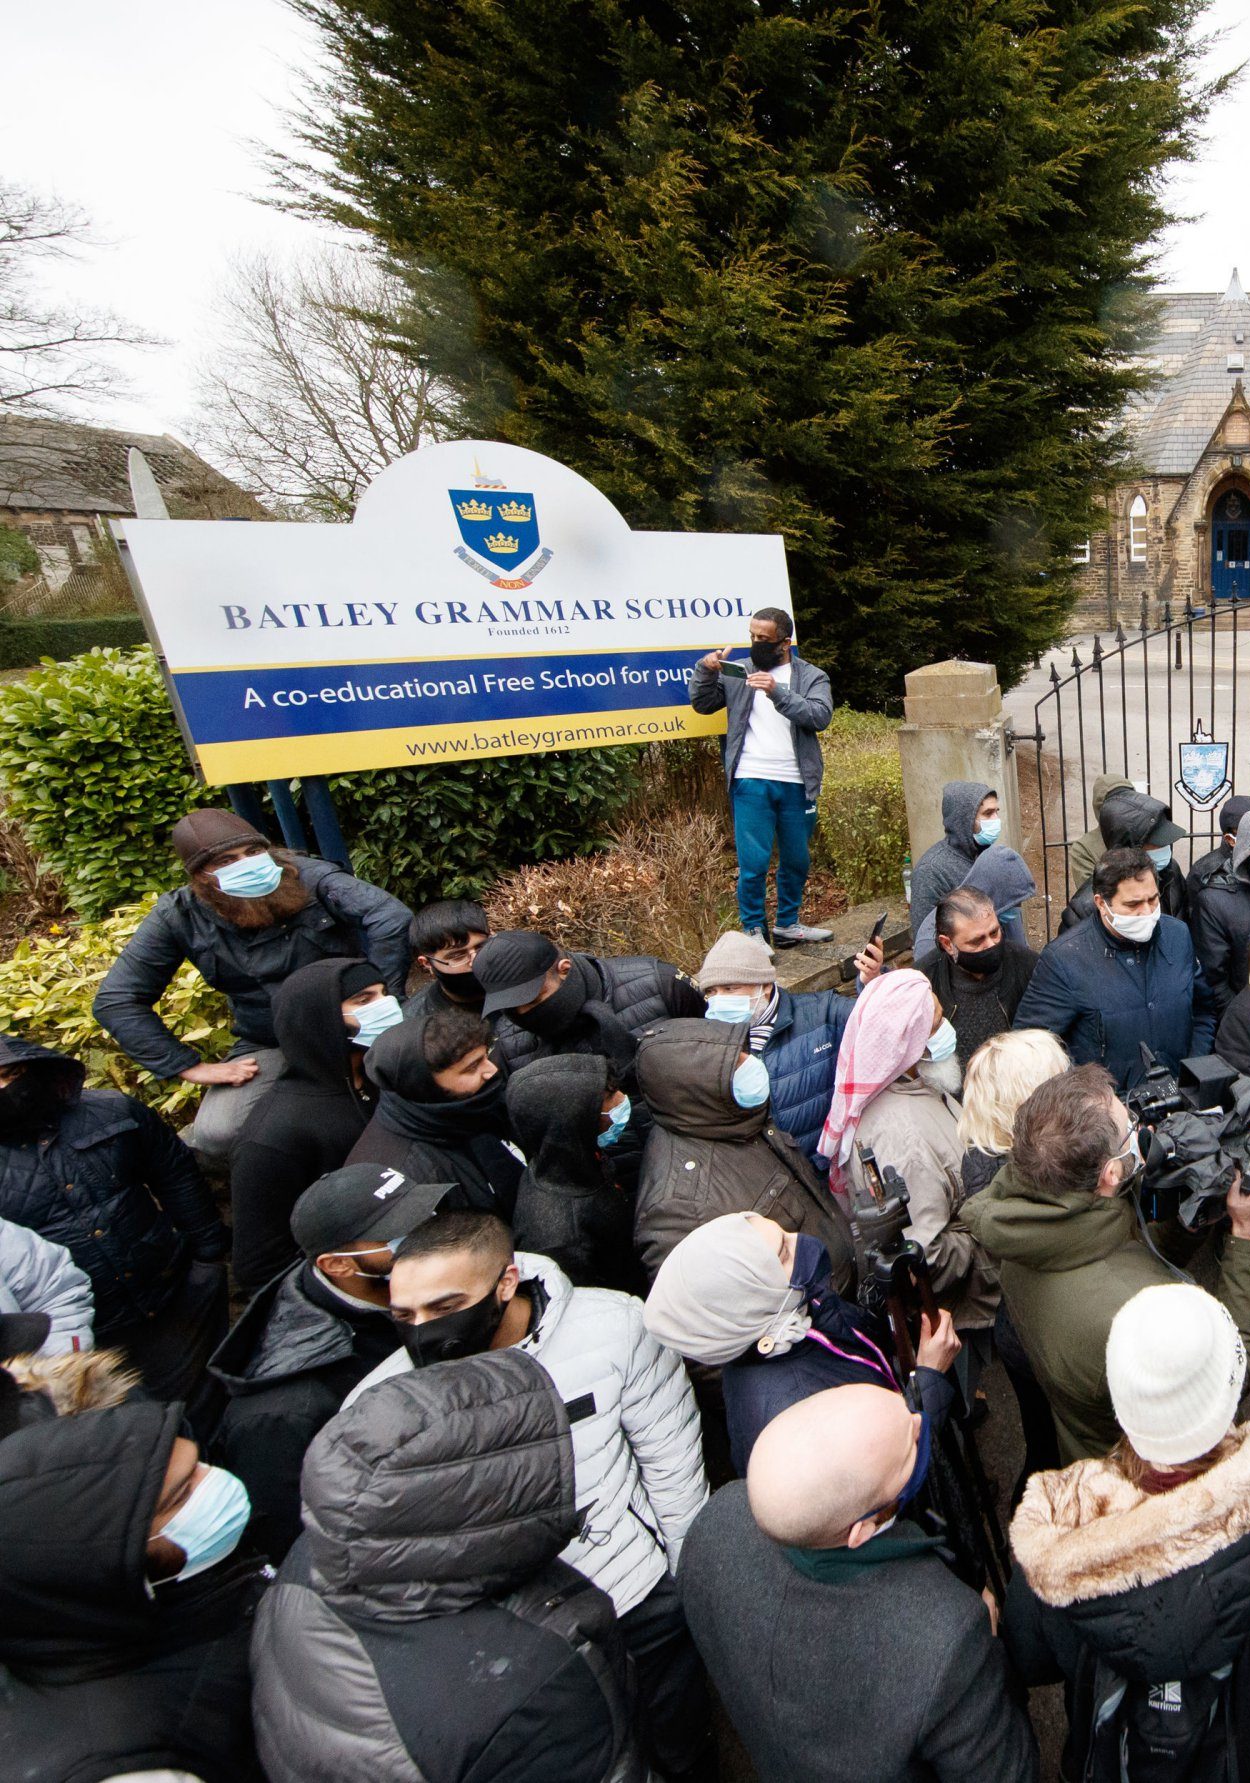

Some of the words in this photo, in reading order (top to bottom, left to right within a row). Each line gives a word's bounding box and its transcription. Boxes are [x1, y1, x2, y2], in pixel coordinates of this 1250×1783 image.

[499, 580, 525, 589] NON
[219, 602, 399, 630] BATLEY
[415, 599, 615, 625] GRAMMAR
[626, 597, 752, 620] SCHOOL
[488, 626, 540, 637] Founded
[544, 625, 571, 635] 1612
[244, 687, 266, 709] A
[272, 674, 478, 707] co-educational
[484, 673, 535, 693] Free
[540, 666, 616, 690] School
[620, 665, 650, 684] for
[655, 667, 694, 687] pup
[405, 716, 686, 756] www.batleygrammar.co.uk
